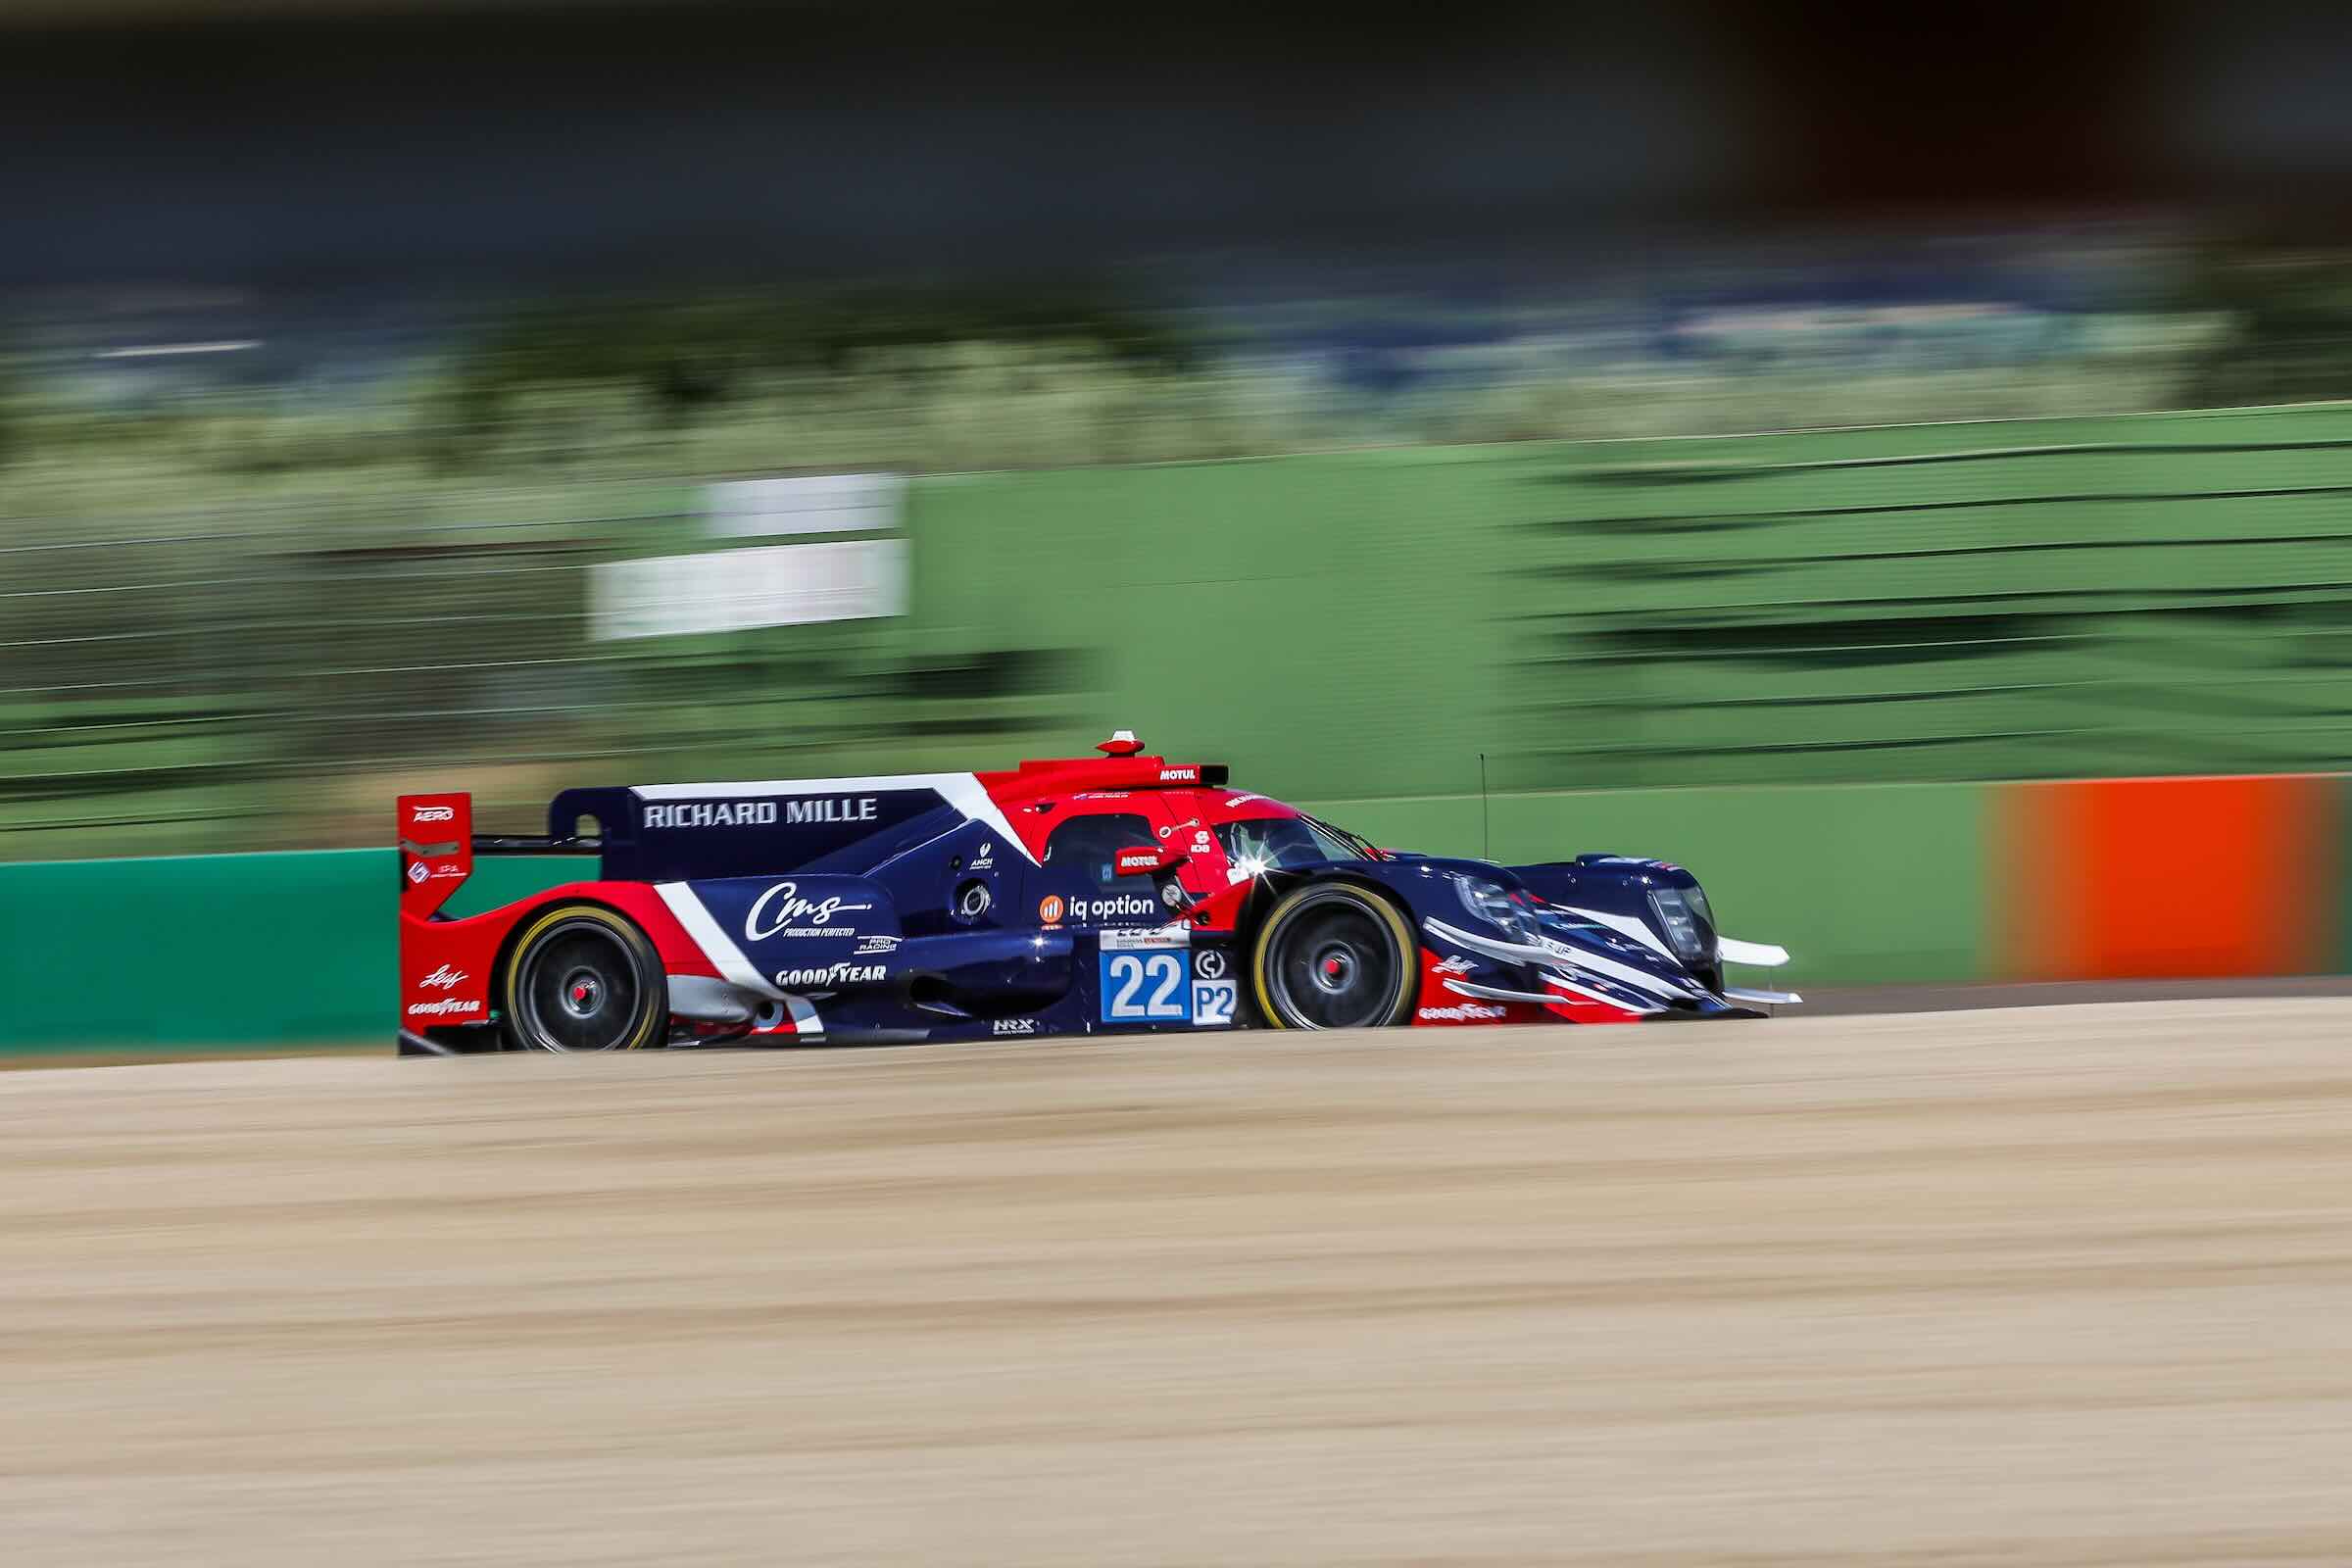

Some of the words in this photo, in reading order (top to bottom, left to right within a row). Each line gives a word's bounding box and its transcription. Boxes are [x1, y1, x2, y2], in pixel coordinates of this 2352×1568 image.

[1160, 769, 1196, 780] MOTUL
[643, 802, 778, 828] RICHARD
[786, 798, 878, 824] MILLE
[1120, 856, 1159, 867] MOTUL
[1069, 896, 1087, 921] iq
[1091, 894, 1154, 920] option
[783, 927, 822, 938] PRODUCTION
[820, 927, 856, 938] PERFECTED
[774, 962, 887, 987] GOODYEAR
[1109, 955, 1183, 1017] 22
[408, 998, 481, 1016] GOODYEAR
[1196, 987, 1233, 1018] P2
[993, 1018, 1035, 1031] NRX
